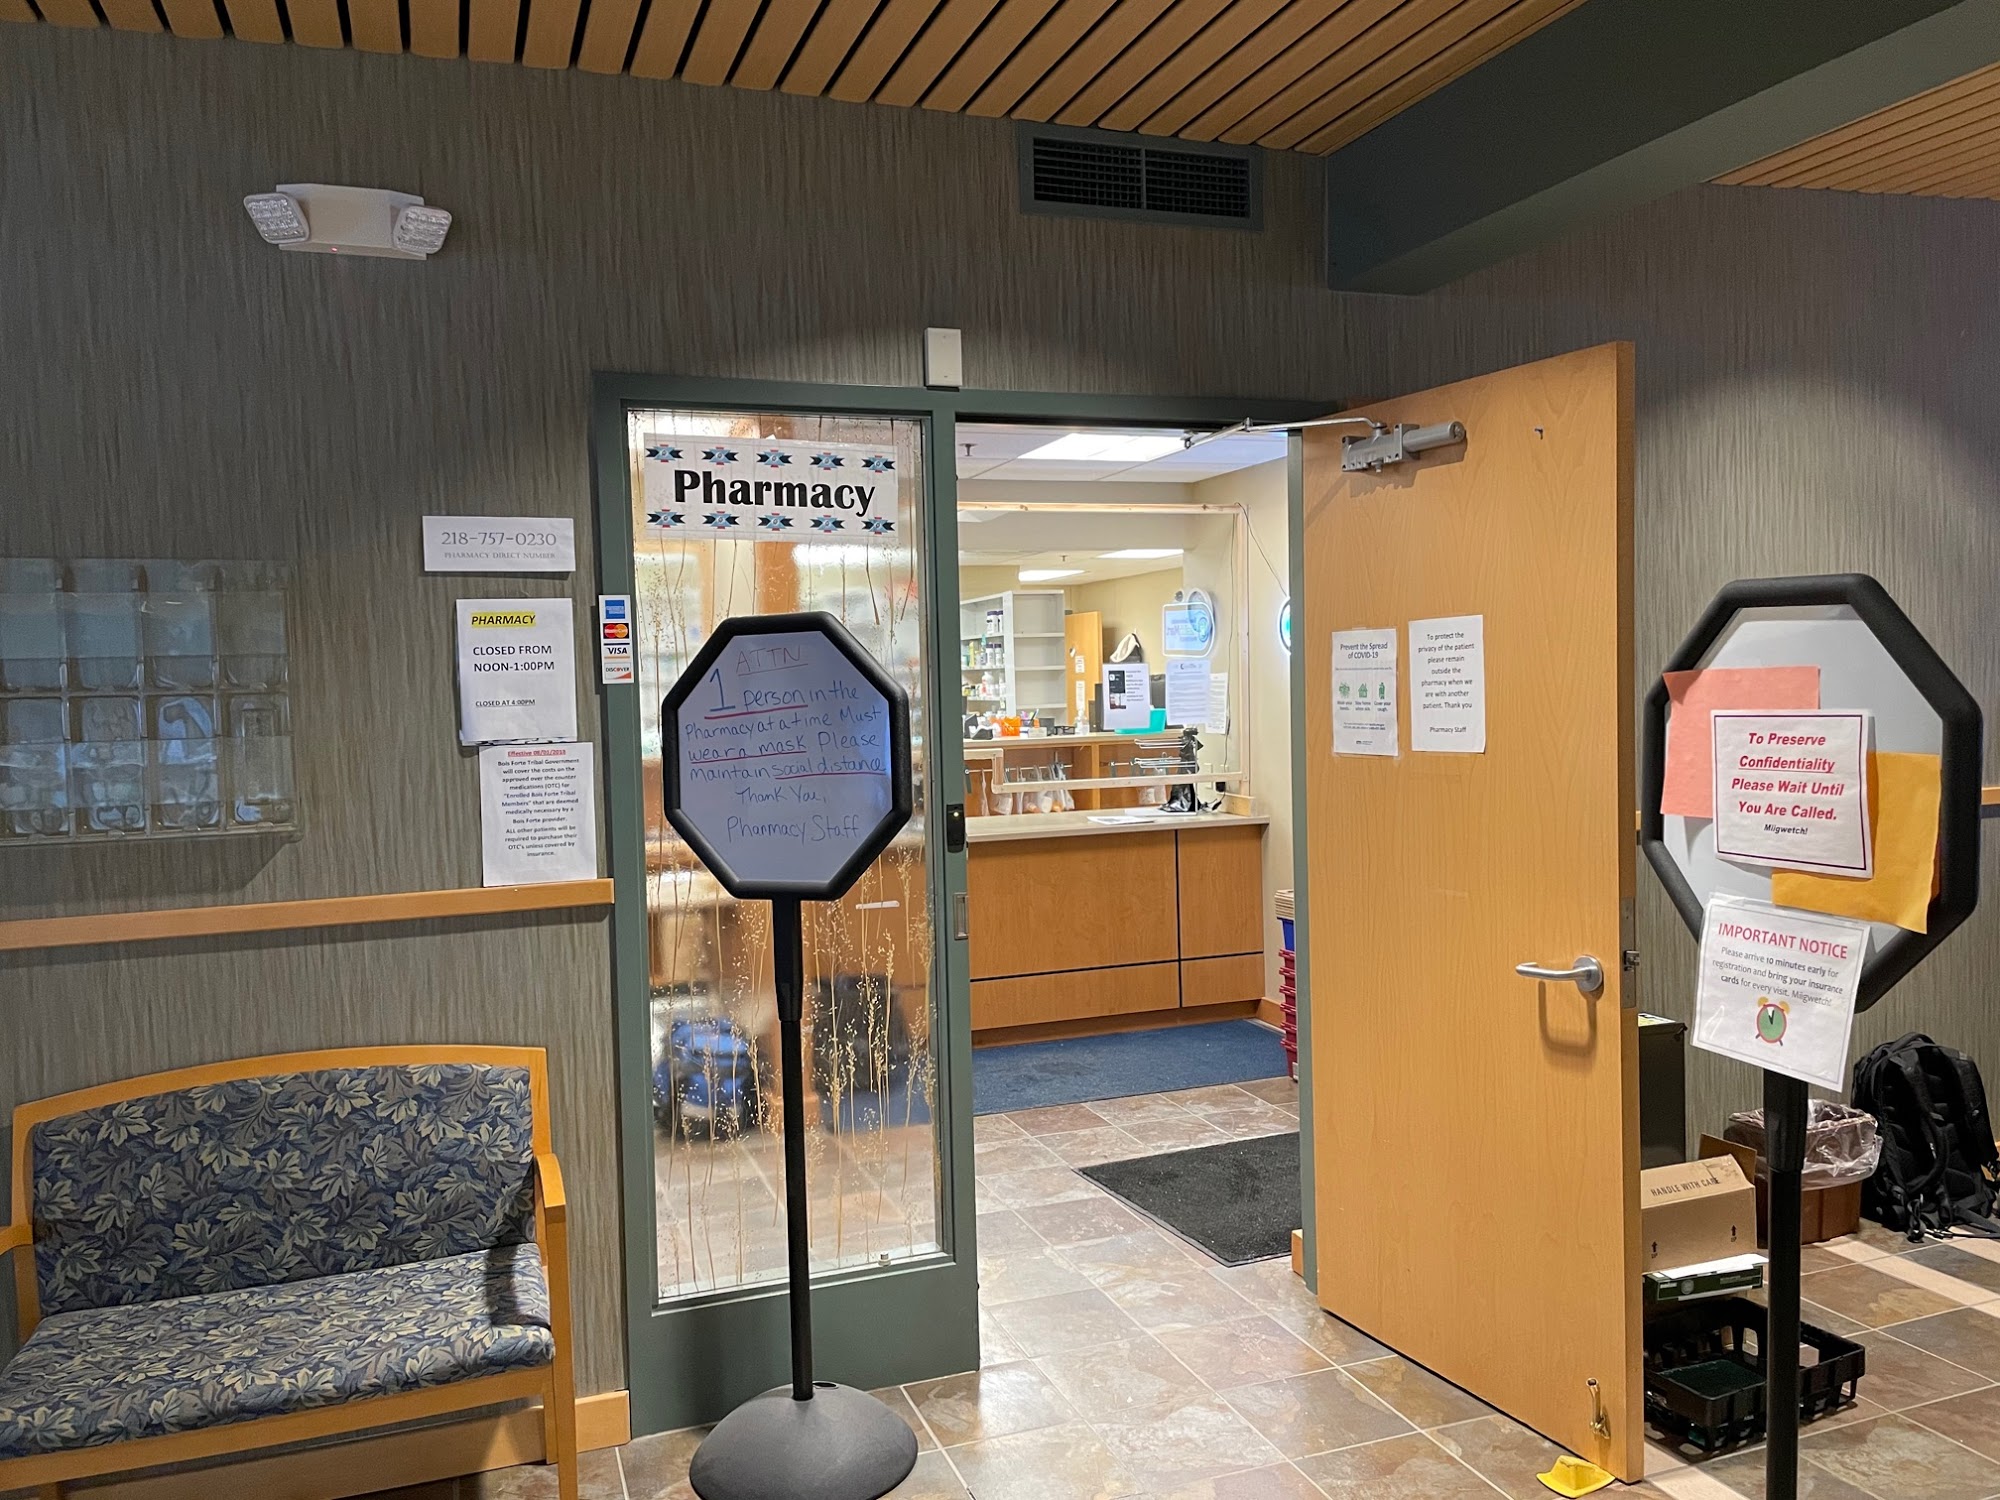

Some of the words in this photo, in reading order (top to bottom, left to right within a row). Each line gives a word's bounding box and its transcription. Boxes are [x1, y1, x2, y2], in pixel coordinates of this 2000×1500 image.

[674, 470, 875, 517] Pharmacy
[441, 532, 556, 546] 218-757-0230
[471, 615, 536, 625] PHARMACY
[473, 646, 515, 656] CLOSED
[519, 645, 552, 654] FROM
[1354, 651, 1378, 659] COVID-19
[1369, 642, 1388, 651] Spread
[474, 662, 554, 672] NOON-1:00PM
[736, 645, 800, 673] ATTN
[709, 668, 736, 712] 1
[744, 689, 804, 711] person
[809, 688, 826, 701] in
[829, 680, 859, 700] the
[686, 722, 753, 741] Pharmacy
[758, 715, 773, 731] at
[779, 719, 790, 729] a
[791, 713, 832, 727] time
[840, 705, 882, 723] Must
[688, 744, 734, 762] wear
[738, 747, 749, 758] a
[759, 736, 804, 757] mask
[818, 731, 880, 752] Please
[1749, 733, 1764, 744] To
[1768, 733, 1826, 746] Preserve
[1739, 756, 1835, 773] Confidentiality
[736, 786, 786, 803] Thank
[1732, 778, 1774, 791] Please
[1778, 780, 1807, 794] Wait
[1811, 783, 1845, 796] Until
[1739, 801, 1761, 814] You
[1764, 803, 1787, 816] Are
[1791, 805, 1837, 820] Called.
[727, 816, 806, 844] Pharmacy
[811, 815, 861, 841] Staff
[1764, 824, 1808, 835] Miigwetch!
[1718, 923, 1797, 948] IMPORTANT
[1799, 937, 1848, 959] NOTICE
[1721, 947, 1743, 958] Please
[1744, 953, 1764, 963] arrive
[1766, 957, 1773, 965] 10
[1775, 959, 1806, 972] minutes
[1807, 965, 1826, 977] early
[1828, 968, 1839, 978] for
[1712, 959, 1751, 974] registration
[1753, 967, 1766, 977] and
[1768, 971, 1788, 984] bring
[1789, 977, 1807, 987] your
[1808, 980, 1843, 995] insurance
[1721, 974, 1739, 985] cards
[1741, 978, 1751, 988] for
[1752, 982, 1772, 995] every
[1773, 986, 1790, 997] visit.
[1792, 990, 1832, 1006] Miigwetch!
[1651, 1185, 1681, 1196] HANDLE
[1681, 1181, 1701, 1191] WITH
